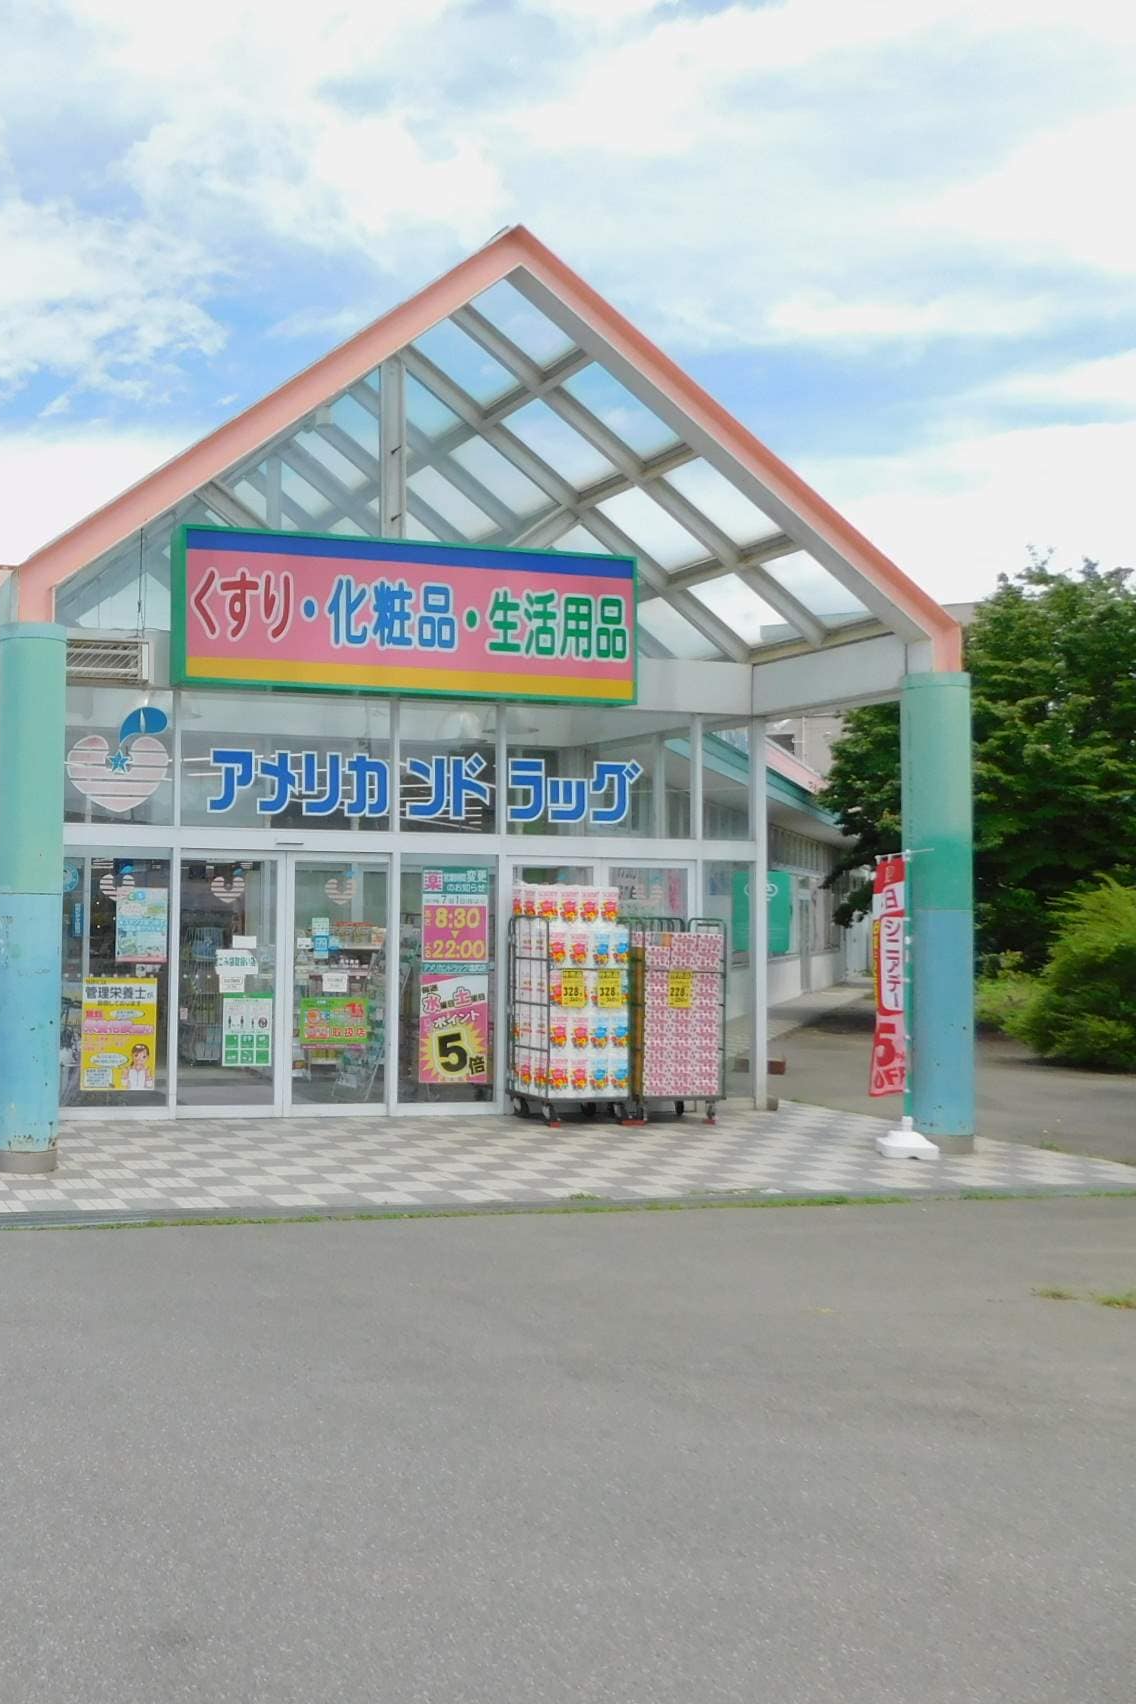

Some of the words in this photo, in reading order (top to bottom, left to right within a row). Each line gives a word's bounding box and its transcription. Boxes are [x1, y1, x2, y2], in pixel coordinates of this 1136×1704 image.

[193, 568, 628, 661] くすり・化粧品・生活用品
[208, 748, 641, 824] アメリカンドラッグ
[435, 907, 480, 928] 8:30
[432, 939, 484, 959] 22:00
[884, 919, 902, 1008] シニアデー
[433, 1011, 480, 1028] ポイント
